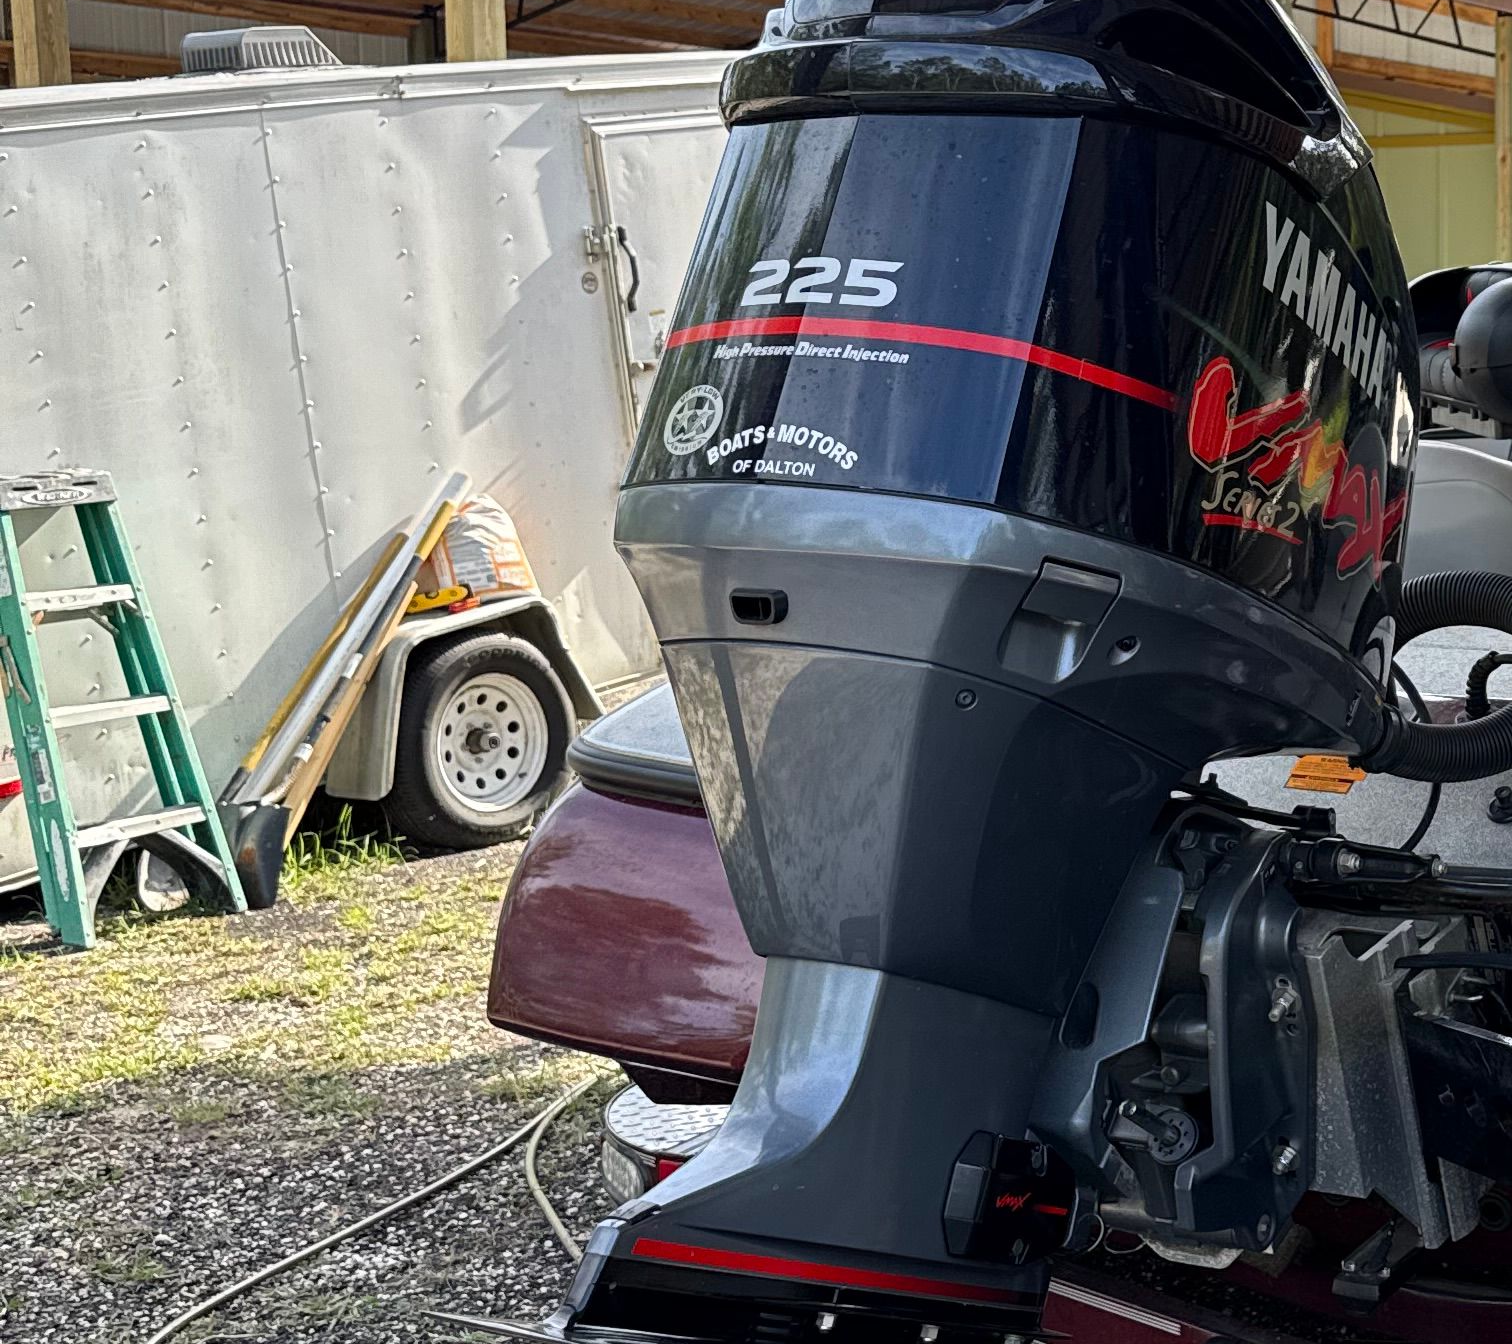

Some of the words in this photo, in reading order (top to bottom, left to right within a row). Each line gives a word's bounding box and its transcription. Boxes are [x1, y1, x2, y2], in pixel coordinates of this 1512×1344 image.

[740, 257, 905, 307] 225
[1262, 201, 1388, 410] YAMAHA
[712, 344, 741, 360] High
[741, 342, 795, 357] Pressure
[795, 341, 842, 359] Direct
[842, 344, 910, 364] Injection
[707, 425, 766, 465] BOATS
[766, 426, 775, 439] &
[777, 424, 858, 471] MOTORS
[732, 460, 753, 474] OF
[754, 460, 815, 477] DALTON
[1278, 503, 1300, 538] 2
